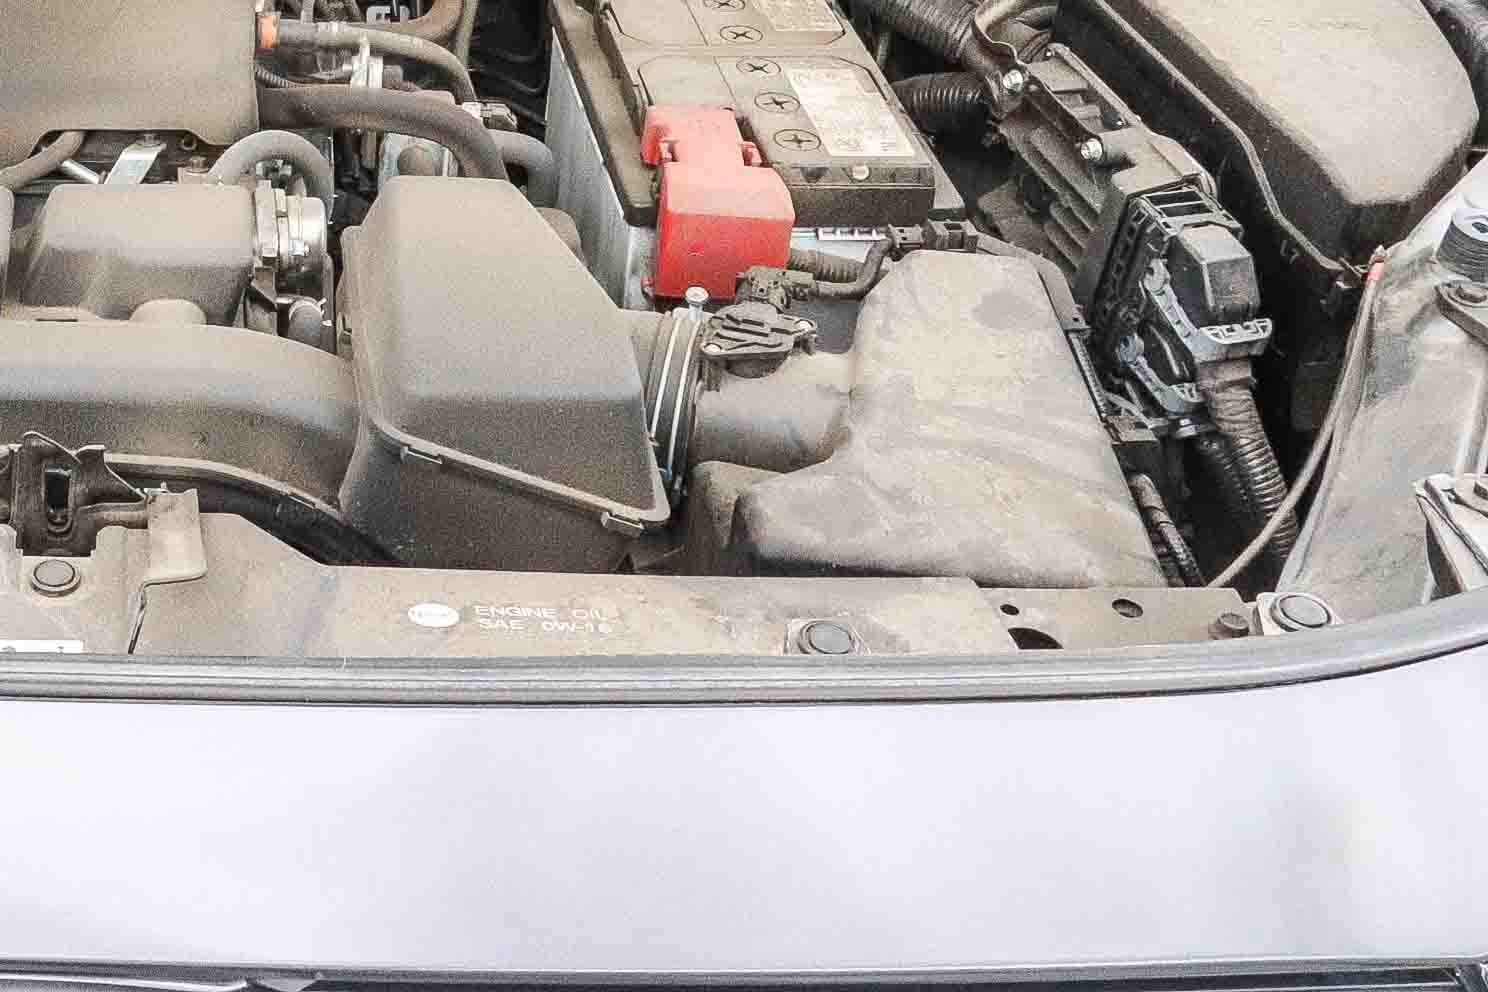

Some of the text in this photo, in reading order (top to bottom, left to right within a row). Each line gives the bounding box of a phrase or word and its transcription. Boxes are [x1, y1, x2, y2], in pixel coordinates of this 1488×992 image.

[475, 605, 609, 621] ENGINE OIL
[478, 619, 525, 631] SAE
